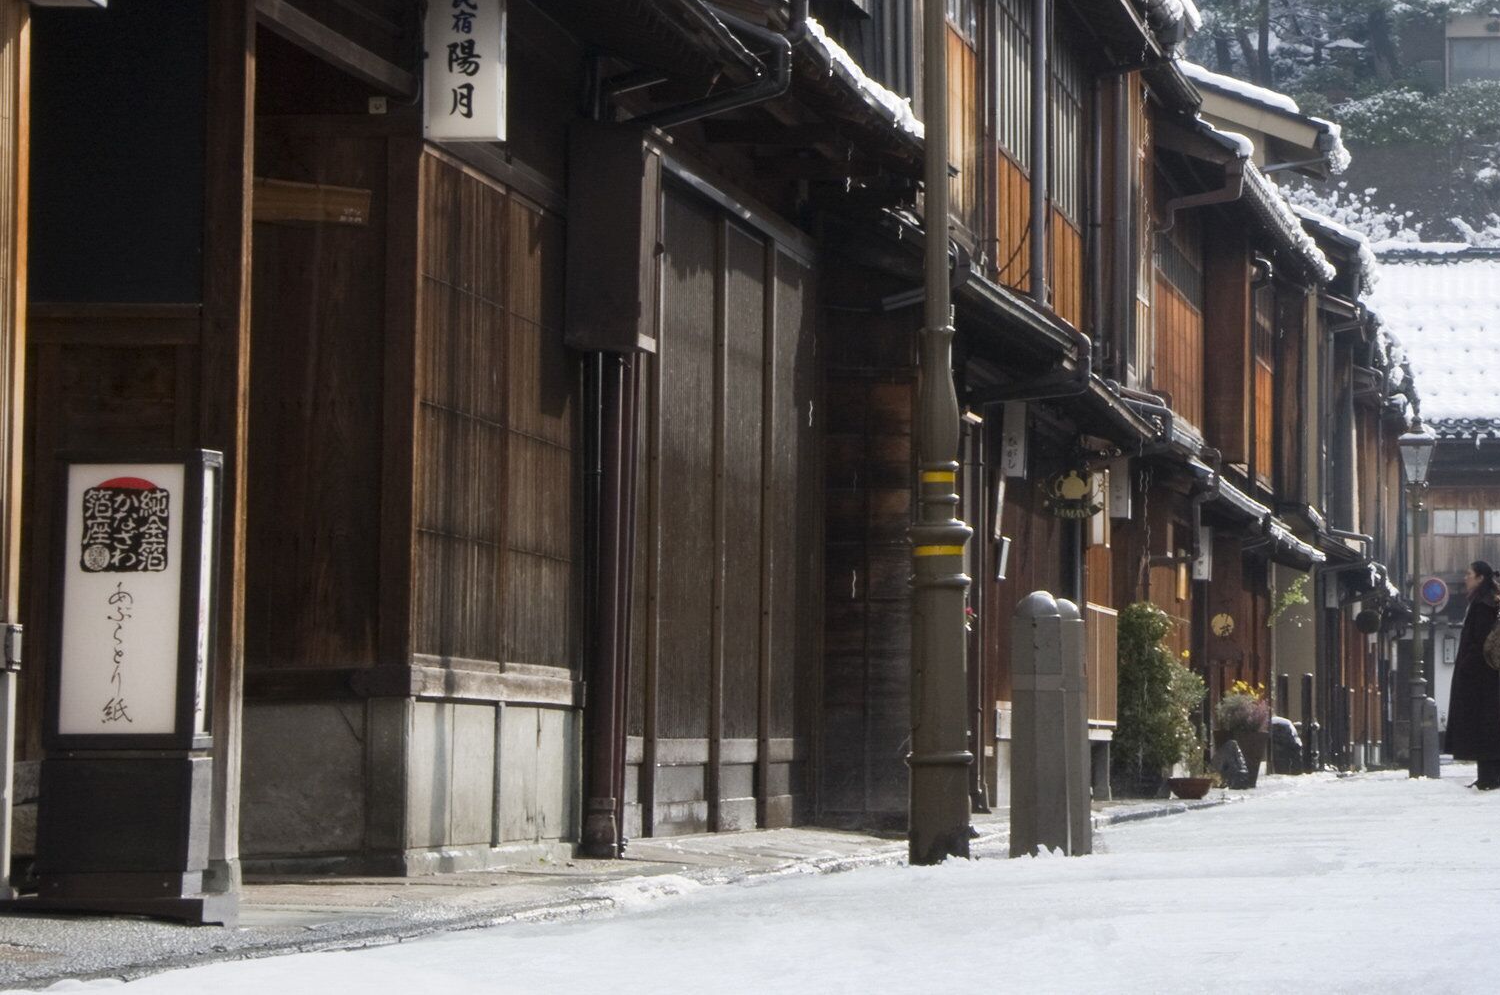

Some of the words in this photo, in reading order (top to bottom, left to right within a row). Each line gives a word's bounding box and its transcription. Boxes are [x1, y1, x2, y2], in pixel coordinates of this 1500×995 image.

[82, 489, 113, 545] 箔座
[110, 493, 139, 566] かなざわ
[137, 490, 168, 571] 純金箔
